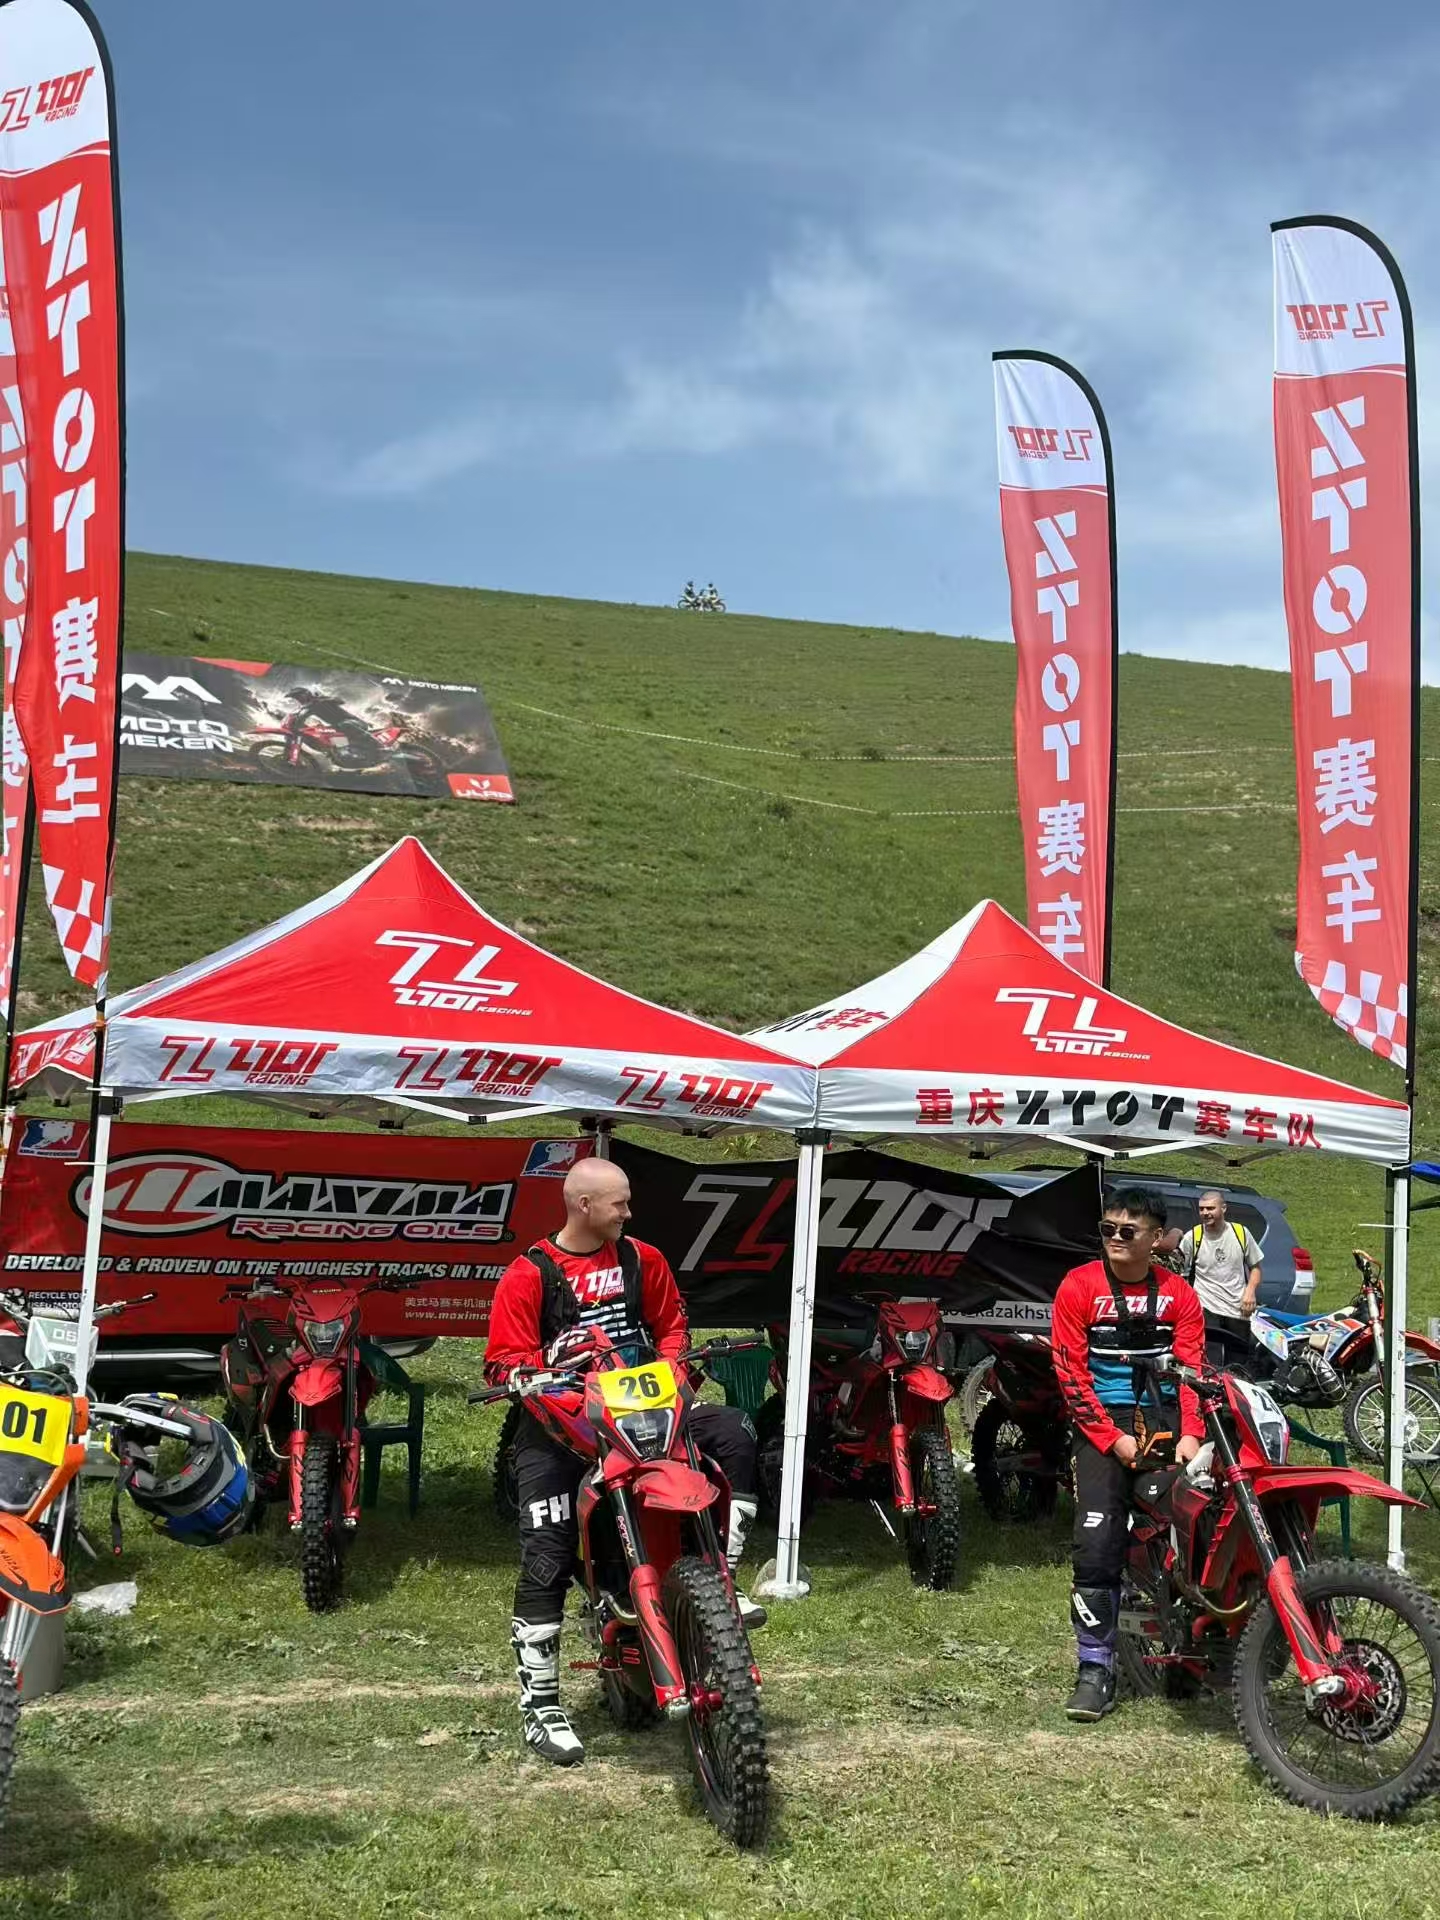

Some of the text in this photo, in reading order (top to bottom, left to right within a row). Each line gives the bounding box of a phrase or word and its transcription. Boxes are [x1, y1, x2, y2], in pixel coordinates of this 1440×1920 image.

[408, 681, 440, 690] MOTO
[120, 715, 230, 737] MOTO
[120, 733, 234, 753] MEKEN
[243, 1072, 313, 1087] RACING
[471, 1082, 535, 1098] RACING
[688, 1104, 750, 1119] RACING
[232, 1217, 503, 1242] RACING OILS
[5, 1254, 113, 1272] DEVELOPD
[116, 1257, 131, 1272] &
[136, 1258, 212, 1275] PROVEN
[213, 1260, 243, 1275] ON
[246, 1261, 279, 1275] THE
[284, 1261, 376, 1277] TOUGHEST
[378, 1262, 448, 1278] TRACKS
[450, 1264, 472, 1278] IN
[837, 1249, 967, 1277] RACING
[28, 1292, 82, 1300] RECYCLE YO
[54, 1302, 81, 1310] MOTO
[405, 1311, 491, 1321] www.maxima
[618, 1372, 661, 1400] 26
[2, 1401, 48, 1444] 01
[529, 1493, 571, 1529] FH
